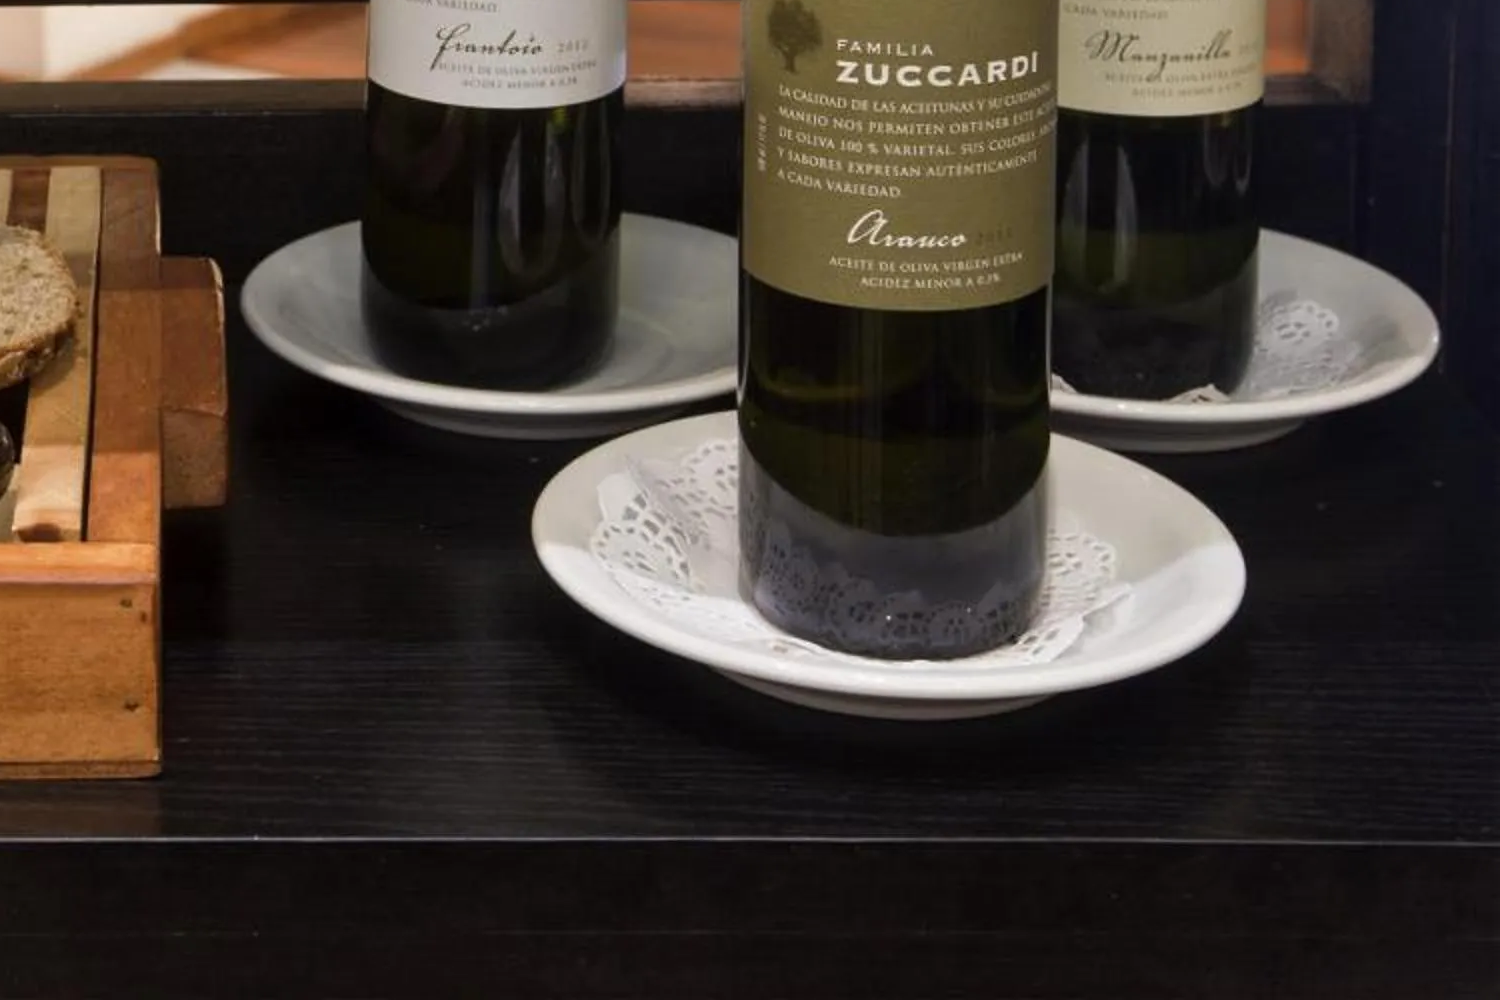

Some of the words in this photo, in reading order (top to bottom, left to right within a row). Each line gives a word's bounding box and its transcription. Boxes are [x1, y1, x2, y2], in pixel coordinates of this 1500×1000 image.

[836, 39, 934, 57] FAMILIA
[836, 50, 1038, 87] ZUCCARDI
[793, 88, 847, 109] CALIDAD
[851, 99, 868, 111] DE
[872, 101, 896, 113] LAS
[899, 102, 974, 114] ACEITUNAS
[976, 101, 985, 112] Y
[779, 106, 829, 127] MANEJO
[833, 117, 862, 132] NOS
[869, 121, 944, 136] PERMITEN
[949, 116, 1009, 134] OBTENER
[779, 126, 793, 140] DE
[795, 131, 836, 149] OLIVA
[840, 140, 863, 153] 100
[867, 143, 879, 155] %
[961, 142, 985, 155] SUS
[777, 146, 785, 158] Y
[788, 150, 843, 171] SABORES
[848, 161, 921, 178] EXPRESAN
[777, 168, 786, 180] A
[787, 171, 823, 190] CADA
[826, 178, 902, 198] VARIEDAD
[847, 209, 968, 248] Arauco
[829, 256, 873, 271] ACEITE
[879, 262, 896, 273] DE
[899, 262, 940, 273] OLIVA
[942, 259, 990, 272] VIRGEN
[861, 277, 912, 289] ACIDEZ
[915, 278, 963, 290] MENOR
[965, 276, 975, 287] A
